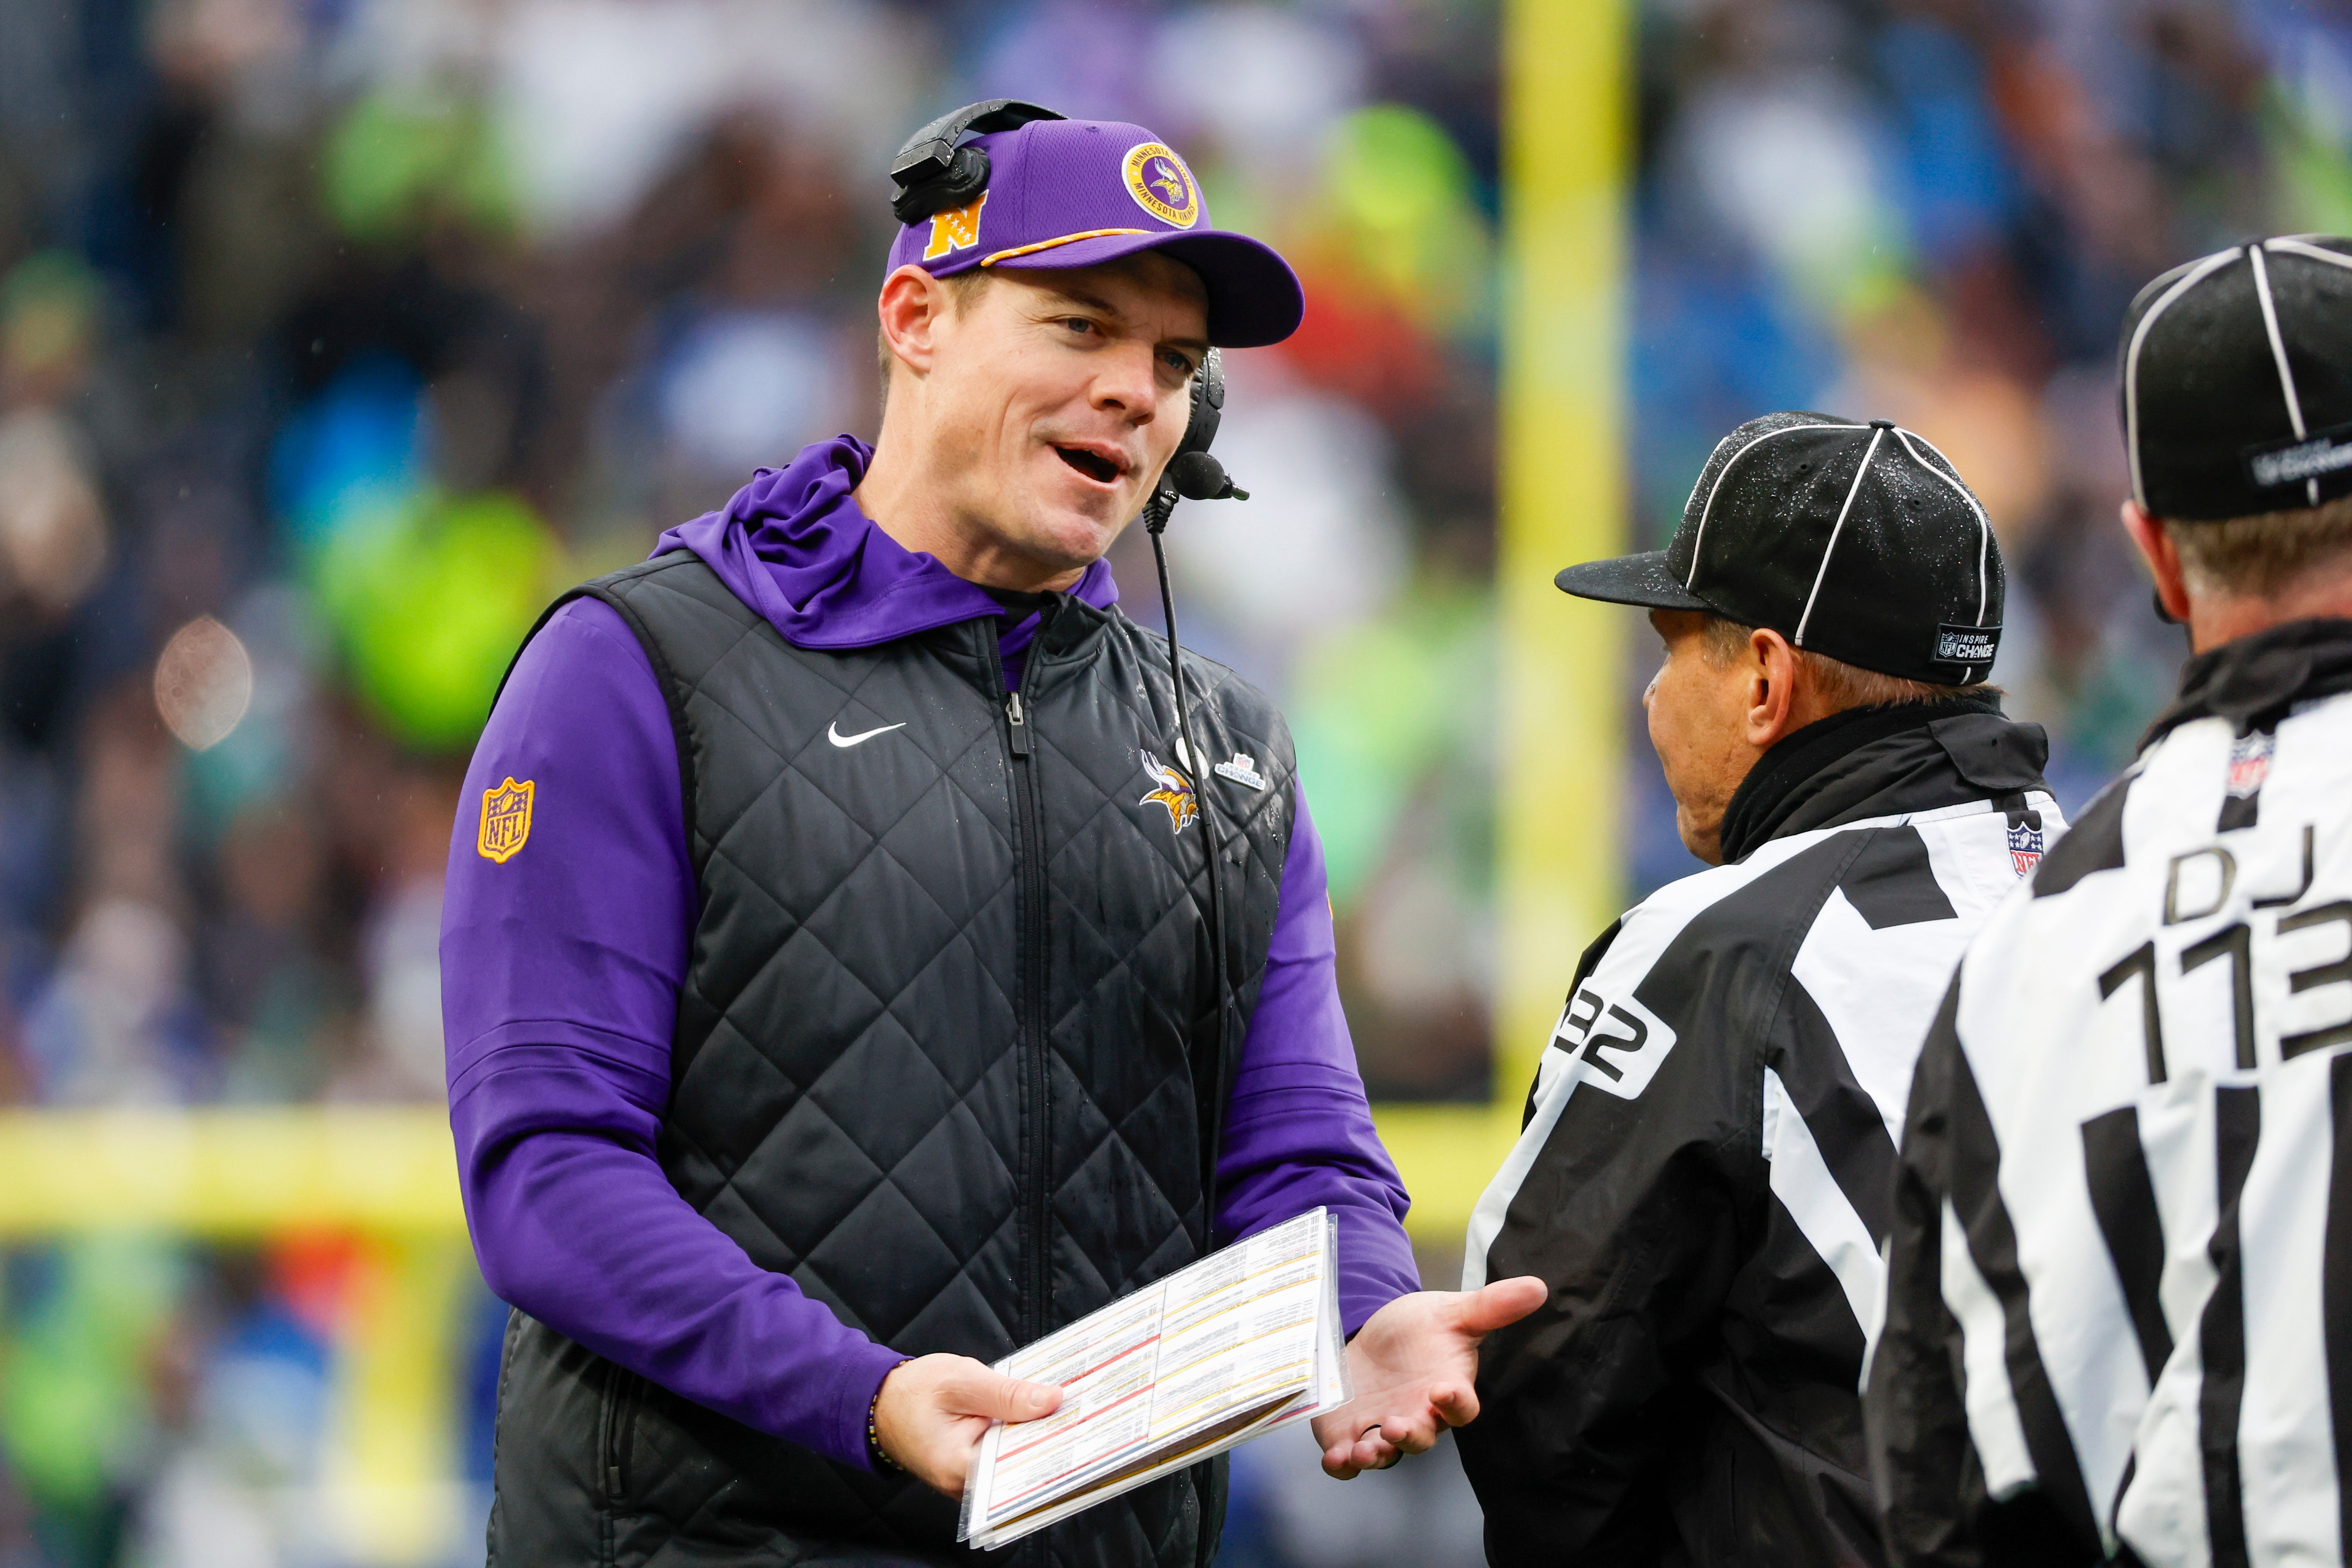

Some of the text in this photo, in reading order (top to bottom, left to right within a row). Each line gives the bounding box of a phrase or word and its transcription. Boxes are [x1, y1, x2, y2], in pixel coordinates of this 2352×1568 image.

[1131, 147, 1192, 189] MINNESOTA VIKINGS
[1135, 182, 1195, 221] MINNESOTA VIKINGS
[1942, 643, 1953, 653] NFL
[1959, 634, 1989, 644] INSPIRE
[1956, 643, 1994, 658] CHANGE
[1227, 764, 1257, 777] INSPIRE
[1237, 760, 1249, 768] NFL
[1218, 766, 1262, 787] CHANGE
[488, 814, 520, 846] NFL
[2163, 825, 2314, 925] DJ
[2098, 900, 2352, 1085] 113
